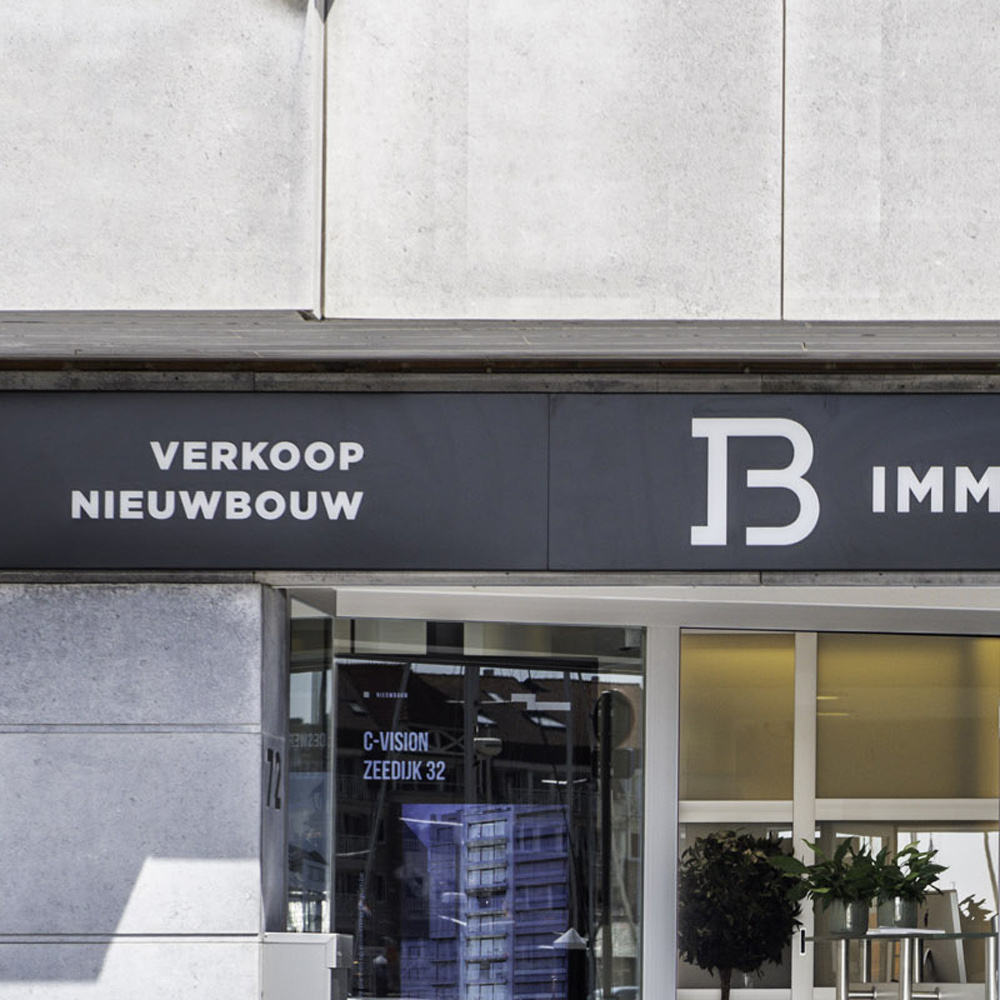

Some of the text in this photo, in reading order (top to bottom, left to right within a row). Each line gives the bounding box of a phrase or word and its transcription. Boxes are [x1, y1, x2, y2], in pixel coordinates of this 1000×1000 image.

[150, 441, 365, 471] VERKOOP
[71, 490, 364, 520] NIEUWBOUW
[363, 731, 429, 752] C-VISION
[363, 760, 446, 780] ZEEDIJK 32
